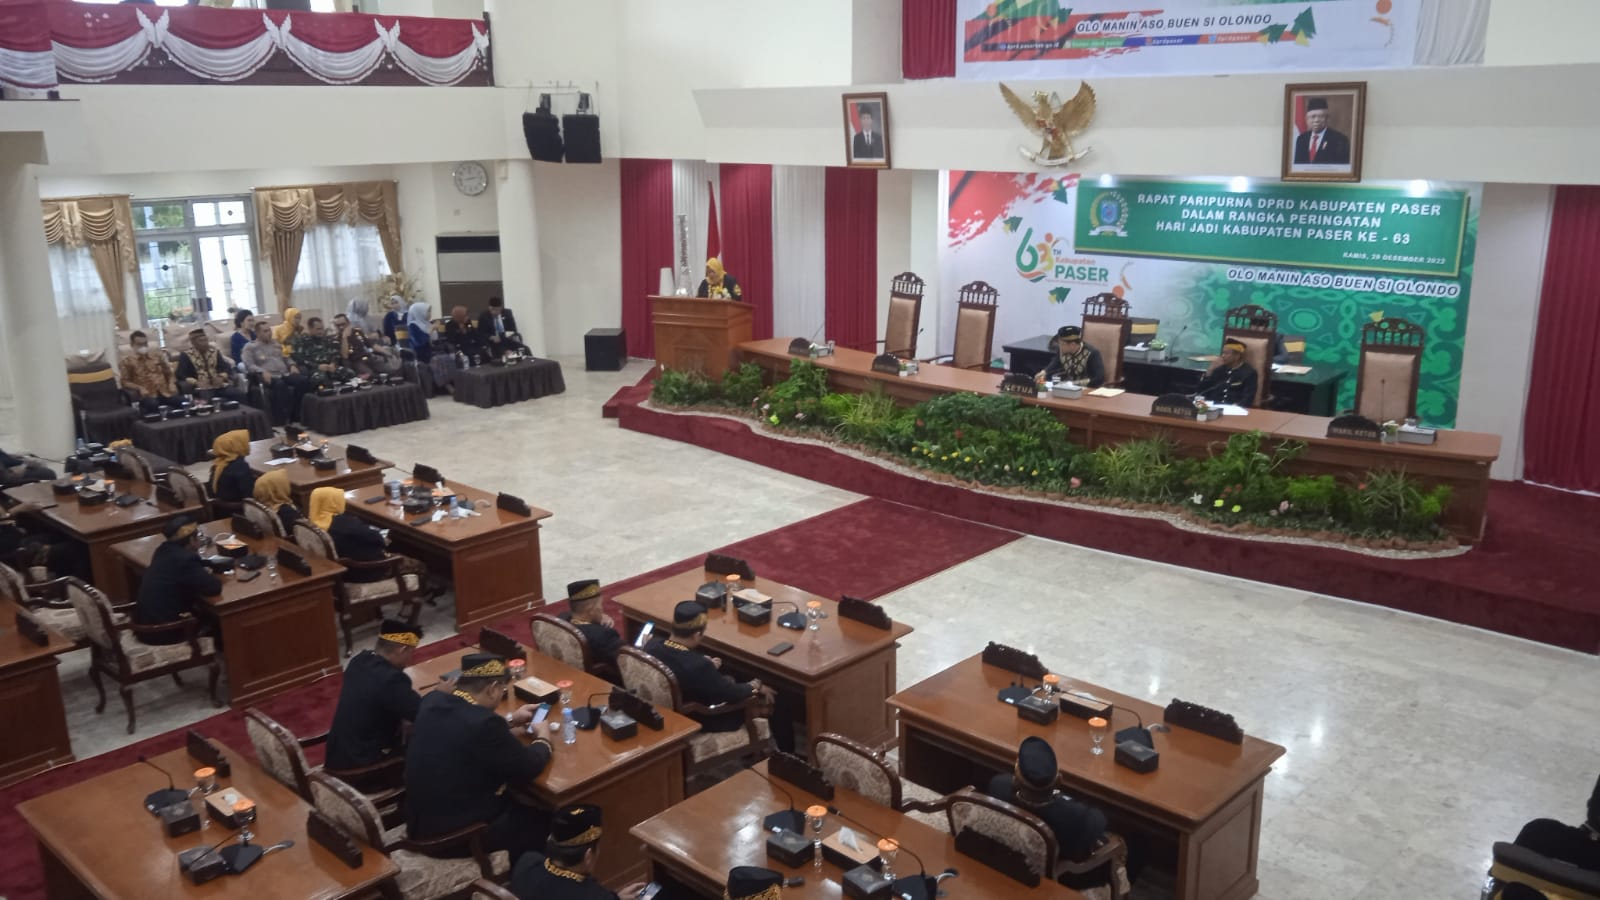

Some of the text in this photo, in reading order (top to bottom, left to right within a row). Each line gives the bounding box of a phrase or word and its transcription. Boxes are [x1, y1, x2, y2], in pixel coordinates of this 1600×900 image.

[1077, 14, 1272, 33] OLO MANIN ASO BUEN SI OLONDO
[1137, 193, 1442, 216] RAPAT PARIPURNA DPRD KABUPATEN PASER
[1181, 208, 1381, 227] DALAM RANGKA PERINGATAN
[1155, 221, 1186, 232] HARI
[1189, 222, 1219, 234] JADI
[1223, 225, 1302, 238] KABUPATEN
[1306, 228, 1353, 242] PASER
[1357, 231, 1378, 243] KE
[1392, 233, 1411, 245] 63
[1056, 265, 1109, 281] PASER
[1228, 268, 1459, 297] OLO MANIN ASO BUEN SI OLONDO
